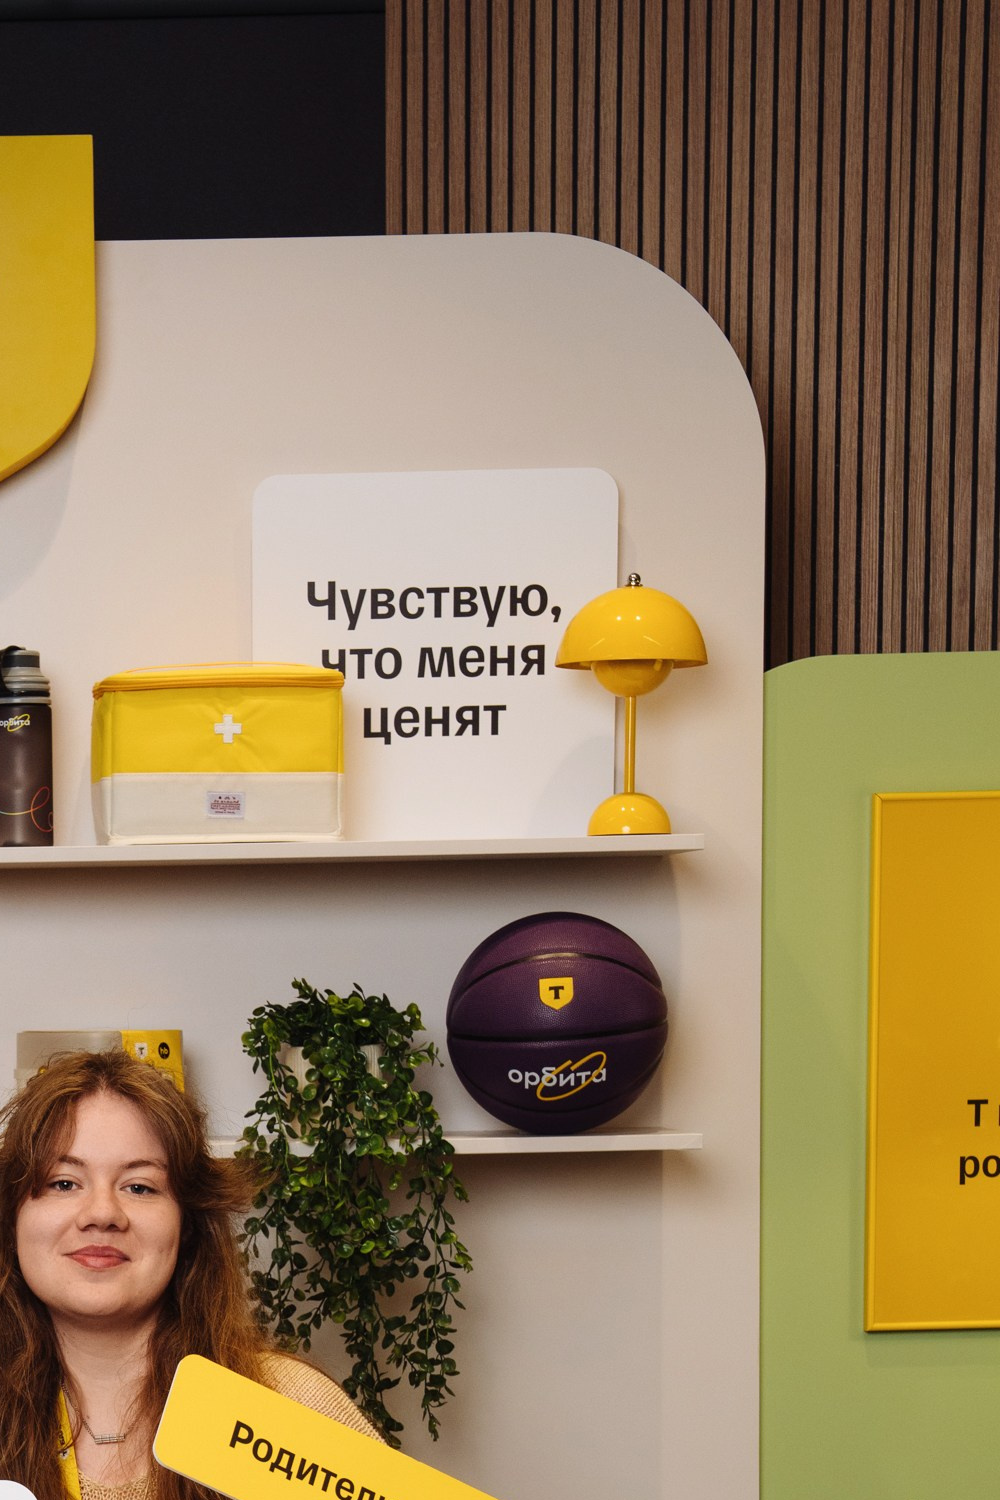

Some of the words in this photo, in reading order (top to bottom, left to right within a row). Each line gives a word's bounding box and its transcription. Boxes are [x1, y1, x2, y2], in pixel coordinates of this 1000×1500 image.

[307, 581, 562, 631] Чувствую,
[322, 647, 403, 680] что
[417, 644, 546, 678] меня
[362, 704, 507, 745] ценят
[548, 985, 565, 1000] Т
[507, 1066, 607, 1090] орбита
[967, 1099, 989, 1127] Т
